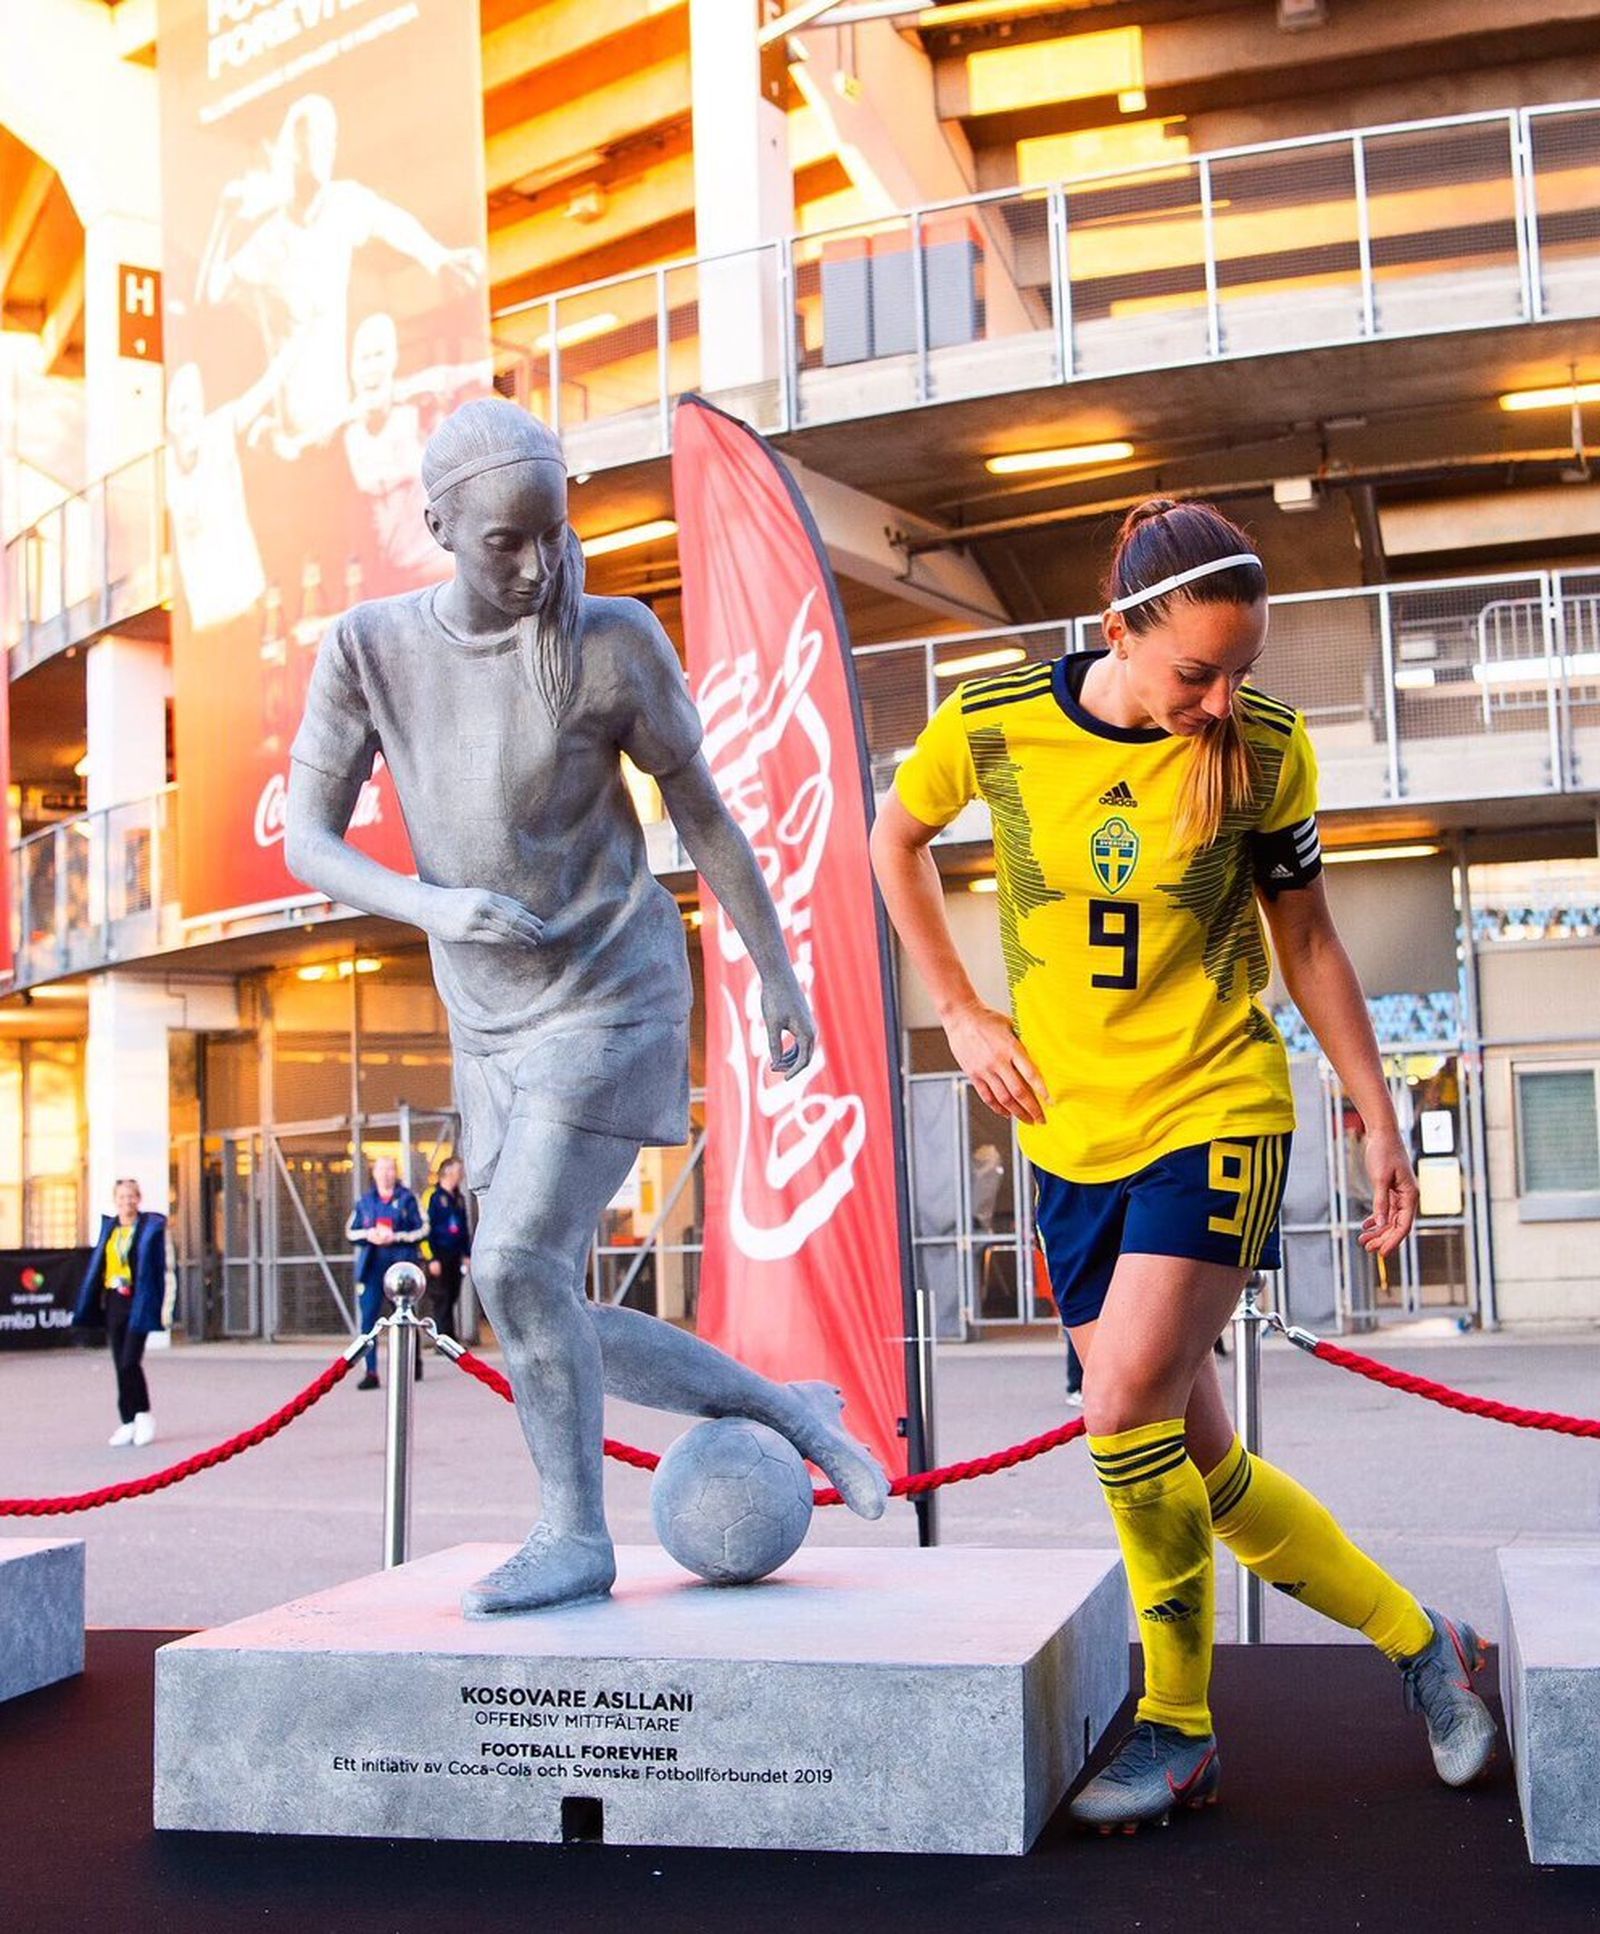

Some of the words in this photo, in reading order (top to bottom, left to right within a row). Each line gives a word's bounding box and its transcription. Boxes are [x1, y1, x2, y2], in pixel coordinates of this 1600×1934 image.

[126, 272, 155, 318] H
[1098, 795, 1138, 808] adidas
[1089, 898, 1140, 990] 9
[1208, 1140, 1252, 1236] 9
[460, 1686, 587, 1708] KOSOVARE
[593, 1691, 694, 1712] ASLLANI
[475, 1710, 559, 1728] OFFENSIV
[564, 1712, 680, 1732] MITTFÄLTARE
[481, 1742, 576, 1759] FOOTBALL
[581, 1745, 678, 1762] FOREVHER
[333, 1756, 356, 1772] Ett
[362, 1757, 418, 1774] initiativ
[424, 1762, 442, 1774] av
[448, 1760, 532, 1777] Coca-Cola
[537, 1764, 568, 1778] och
[573, 1764, 640, 1780] Svenska
[645, 1766, 789, 1783] Fotbollförbundet
[794, 1768, 833, 1784] 2019
